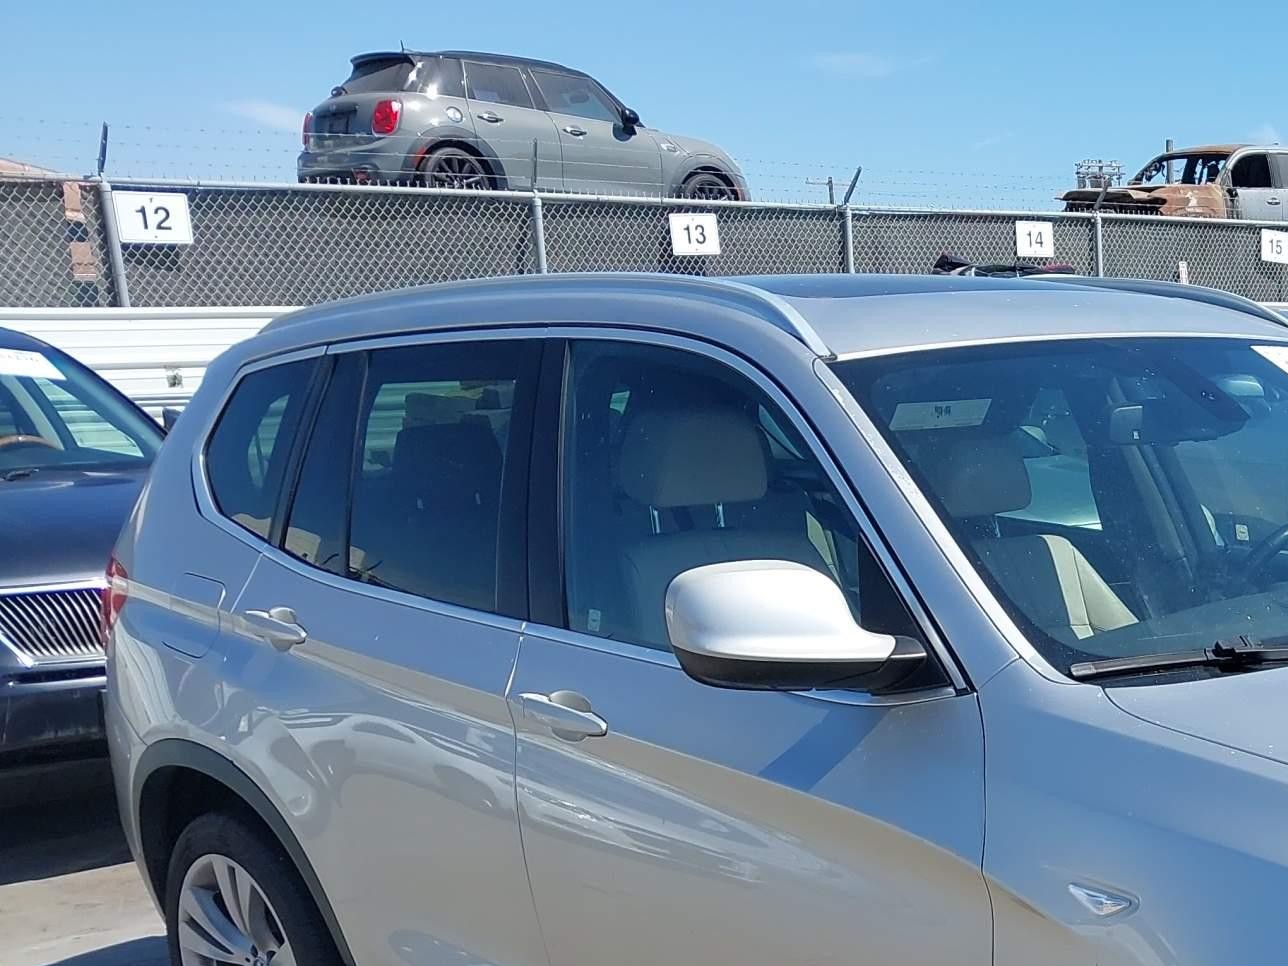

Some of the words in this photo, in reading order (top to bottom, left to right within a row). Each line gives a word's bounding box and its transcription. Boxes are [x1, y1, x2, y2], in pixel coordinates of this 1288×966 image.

[135, 204, 173, 231] 12
[683, 223, 707, 245] 13
[1026, 230, 1044, 248] 14
[1268, 238, 1283, 255] 15
